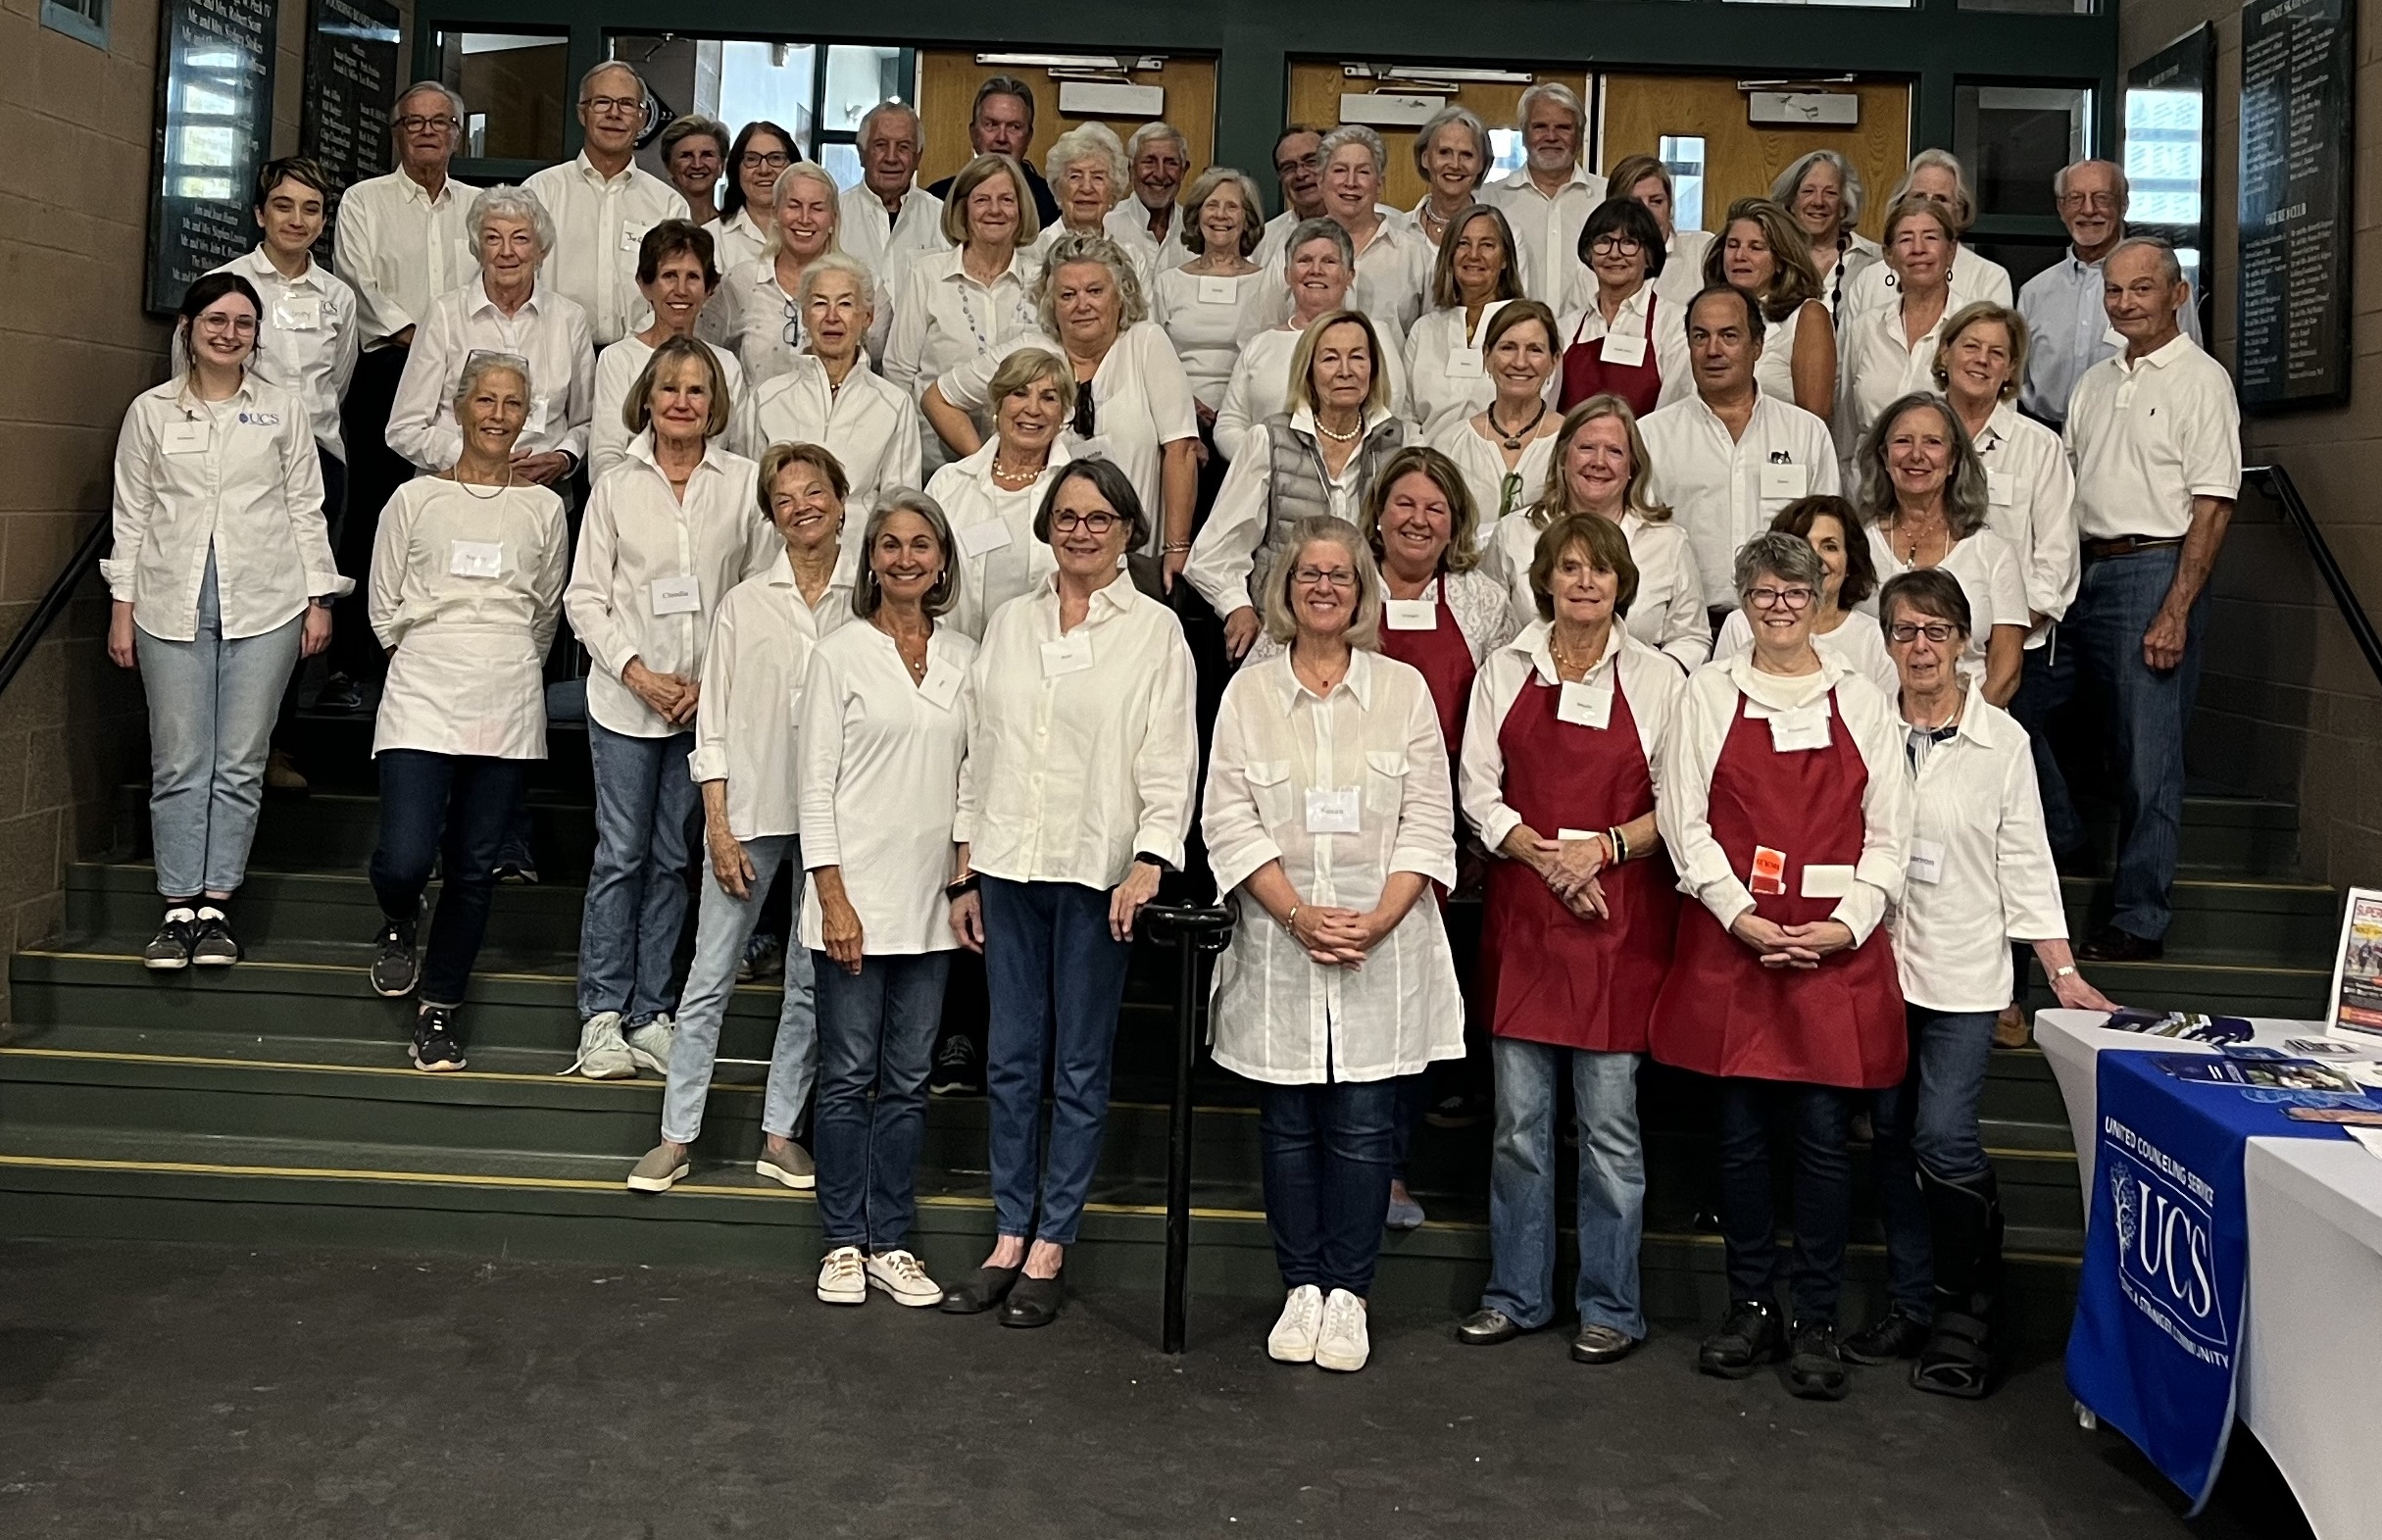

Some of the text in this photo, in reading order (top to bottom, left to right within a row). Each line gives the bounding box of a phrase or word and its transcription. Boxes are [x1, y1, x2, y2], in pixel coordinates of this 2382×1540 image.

[249, 413, 280, 424] UCS
[2105, 1116, 2137, 1149] UNITED
[2137, 1179, 2211, 1318] UCS
